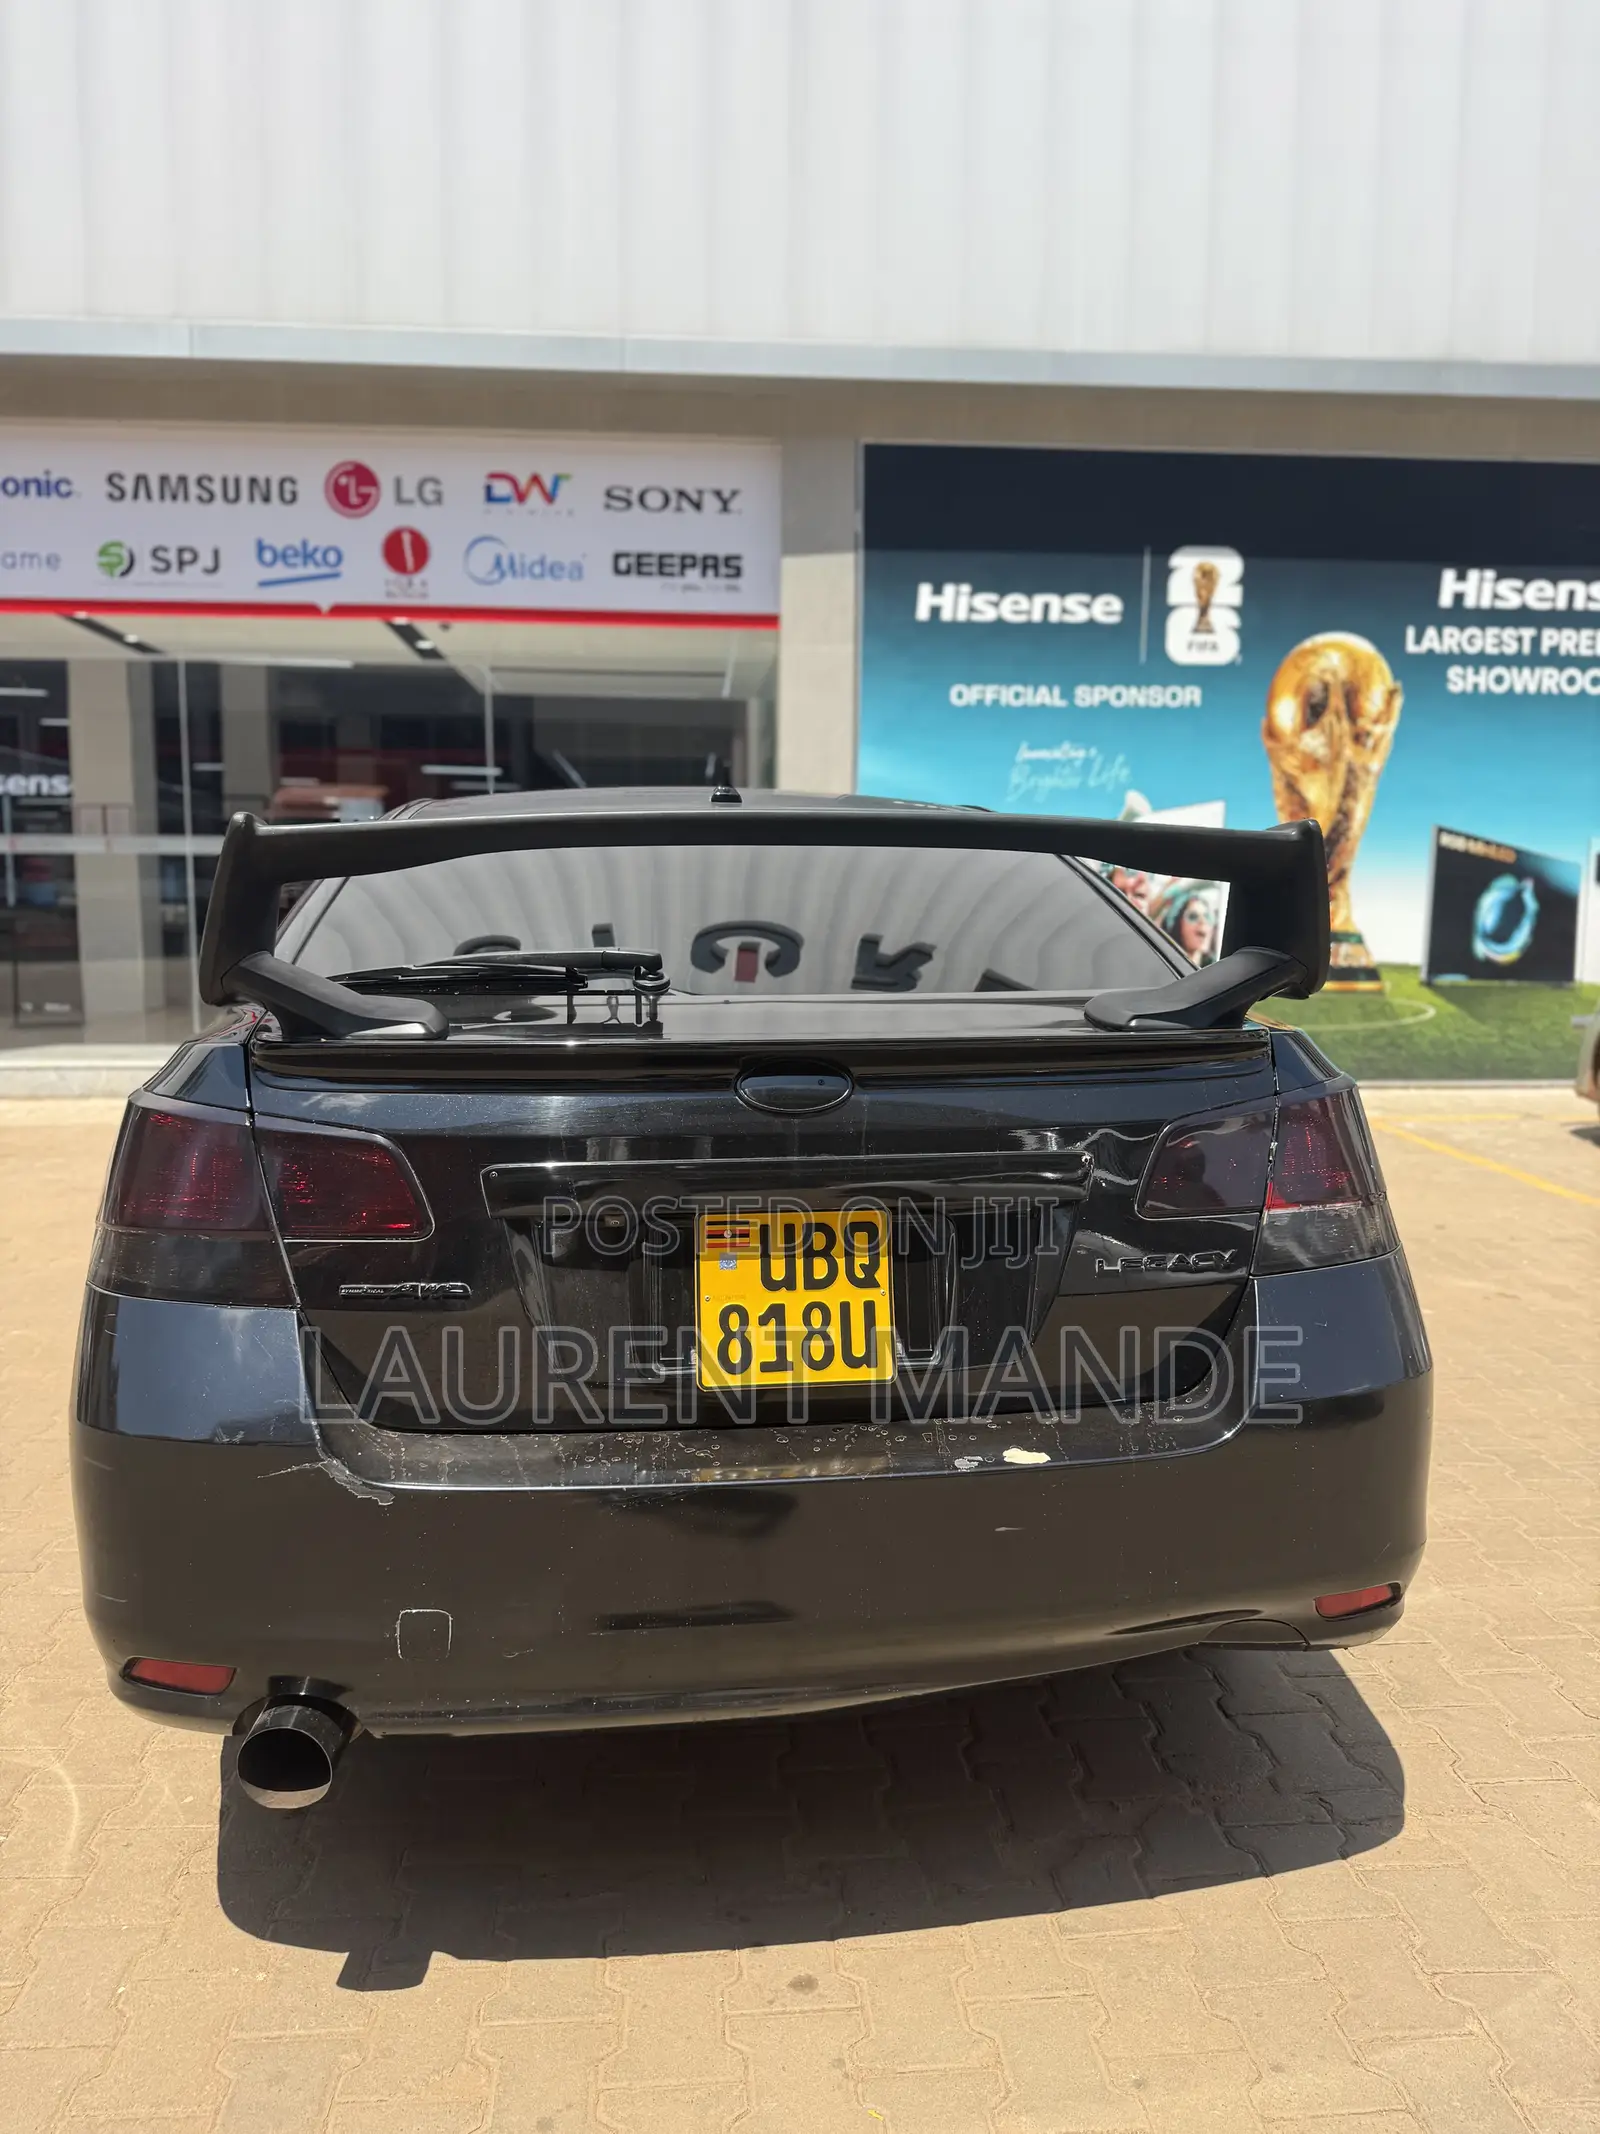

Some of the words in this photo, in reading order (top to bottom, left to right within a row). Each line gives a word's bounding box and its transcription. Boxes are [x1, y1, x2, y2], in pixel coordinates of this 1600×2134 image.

[105, 472, 298, 506] SAMSUNG
[394, 475, 444, 507] LG
[603, 486, 741, 515] SONY
[150, 545, 221, 575] SPJ
[255, 538, 344, 569] beko
[482, 551, 586, 583] Midea
[612, 552, 744, 579] GEEPAS
[915, 583, 1124, 624] Hisense
[1405, 626, 1537, 656] LARGEST
[1540, 628, 1600, 658] PRE
[950, 684, 1068, 708] OFFICIAL
[1074, 685, 1203, 708] SPONSOR
[759, 1221, 881, 1291] UBQ
[1096, 1250, 1237, 1273] LEGACY
[717, 1300, 878, 1376] 818U
